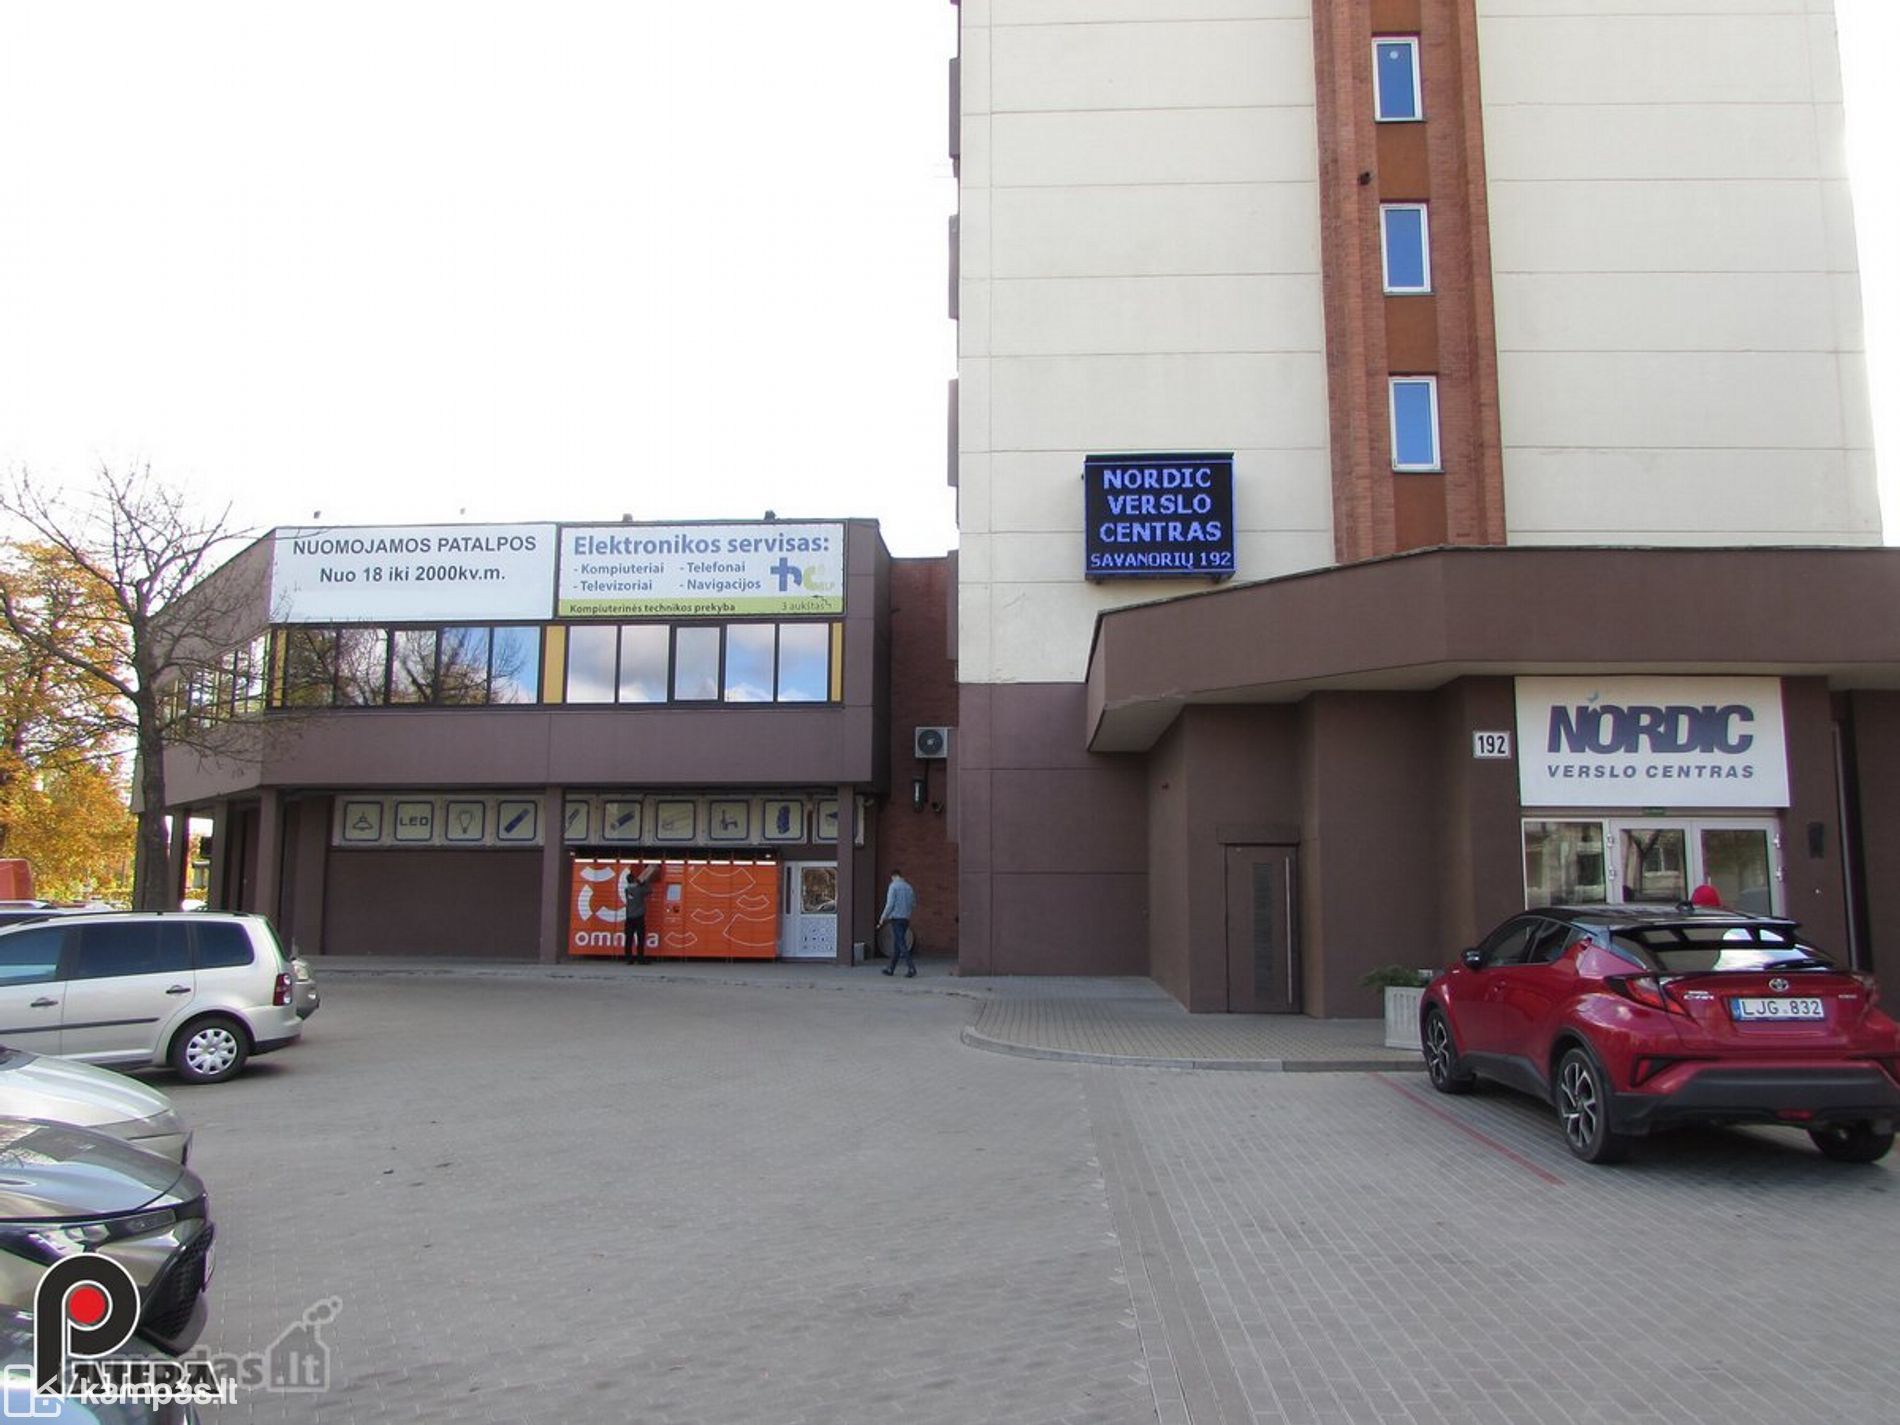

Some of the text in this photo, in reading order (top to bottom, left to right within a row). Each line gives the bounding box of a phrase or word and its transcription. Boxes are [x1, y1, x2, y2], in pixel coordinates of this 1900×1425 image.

[1104, 468, 1211, 490] NORDIC
[1107, 494, 1212, 515] VERSLO
[1099, 521, 1222, 543] CENTRAS
[293, 536, 537, 555] NUOMOJAMOS PATALPOS
[573, 533, 829, 555] Elektronikos servisas:
[1200, 551, 1232, 566] 192
[320, 567, 356, 582] Nuo
[363, 567, 383, 582] 18
[388, 566, 410, 582] iki
[1547, 704, 1754, 755] NORDIC
[1477, 734, 1506, 754] 192
[1547, 764, 1754, 779] VERSLO CENTRAS
[399, 817, 429, 827] LED
[1742, 1000, 1822, 1016] LJG 832
